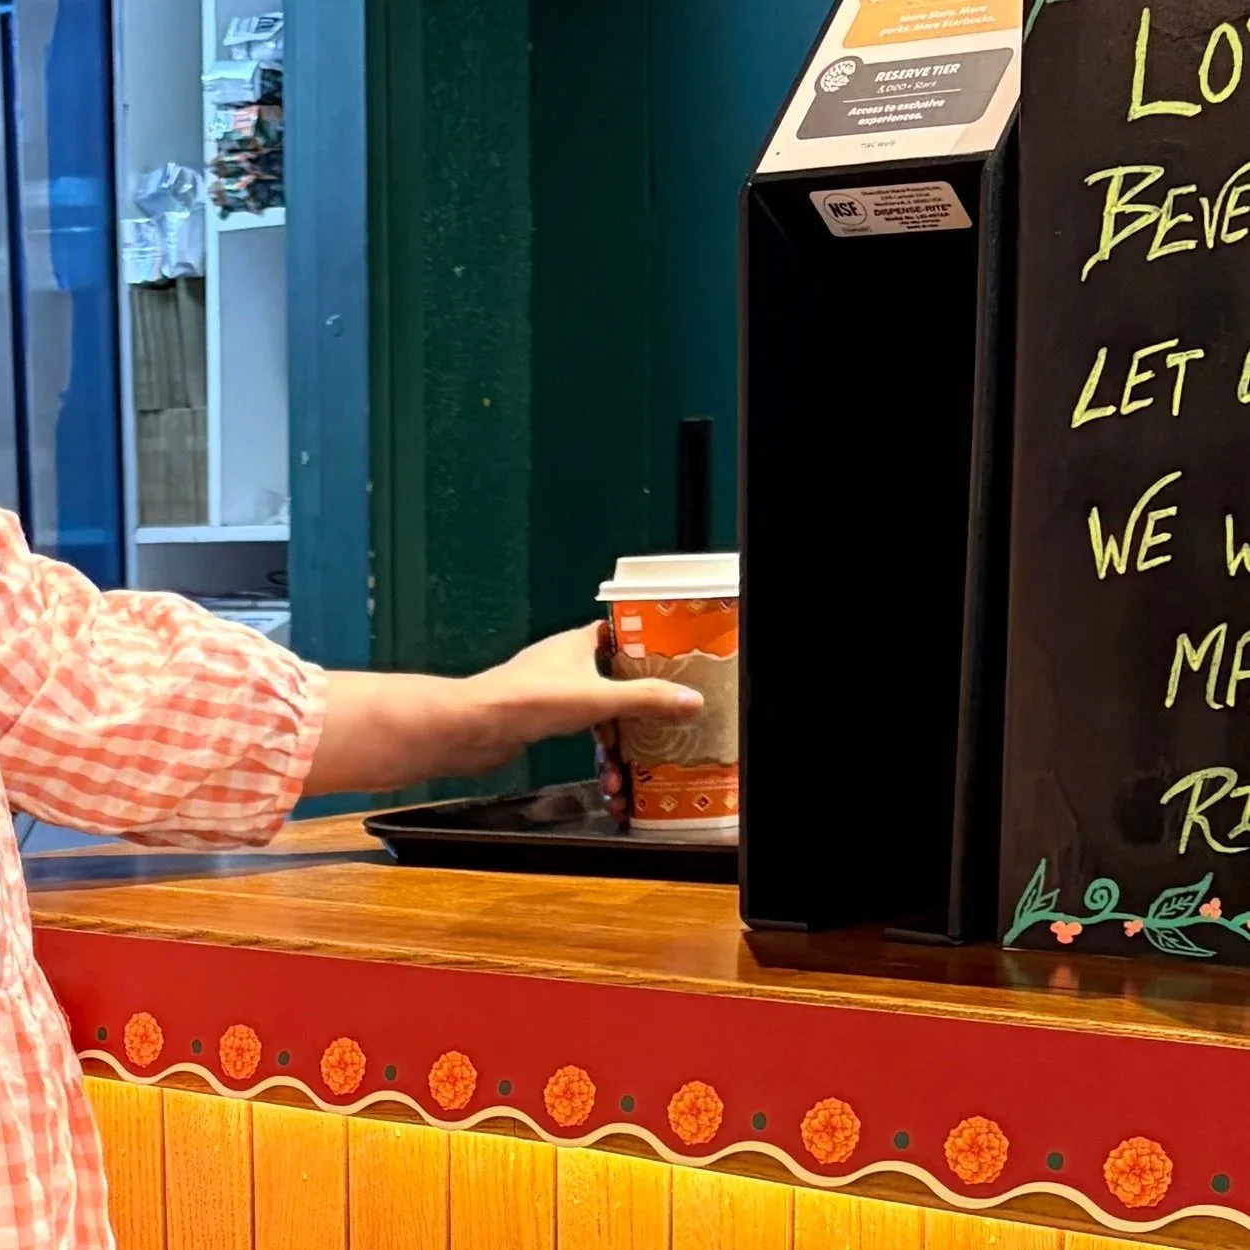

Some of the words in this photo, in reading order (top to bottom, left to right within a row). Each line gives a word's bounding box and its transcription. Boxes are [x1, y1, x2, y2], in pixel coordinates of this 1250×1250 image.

[875, 66, 931, 83] RESERVE
[932, 63, 961, 77] TIER
[1128, 7, 1250, 122] LO
[847, 105, 883, 116] Access
[883, 103, 896, 113] to
[897, 98, 946, 111] exclusive
[857, 112, 923, 126] experiences.
[828, 201, 859, 218] NSF
[1071, 338, 1205, 429] LET
[1088, 470, 1182, 580] WE
